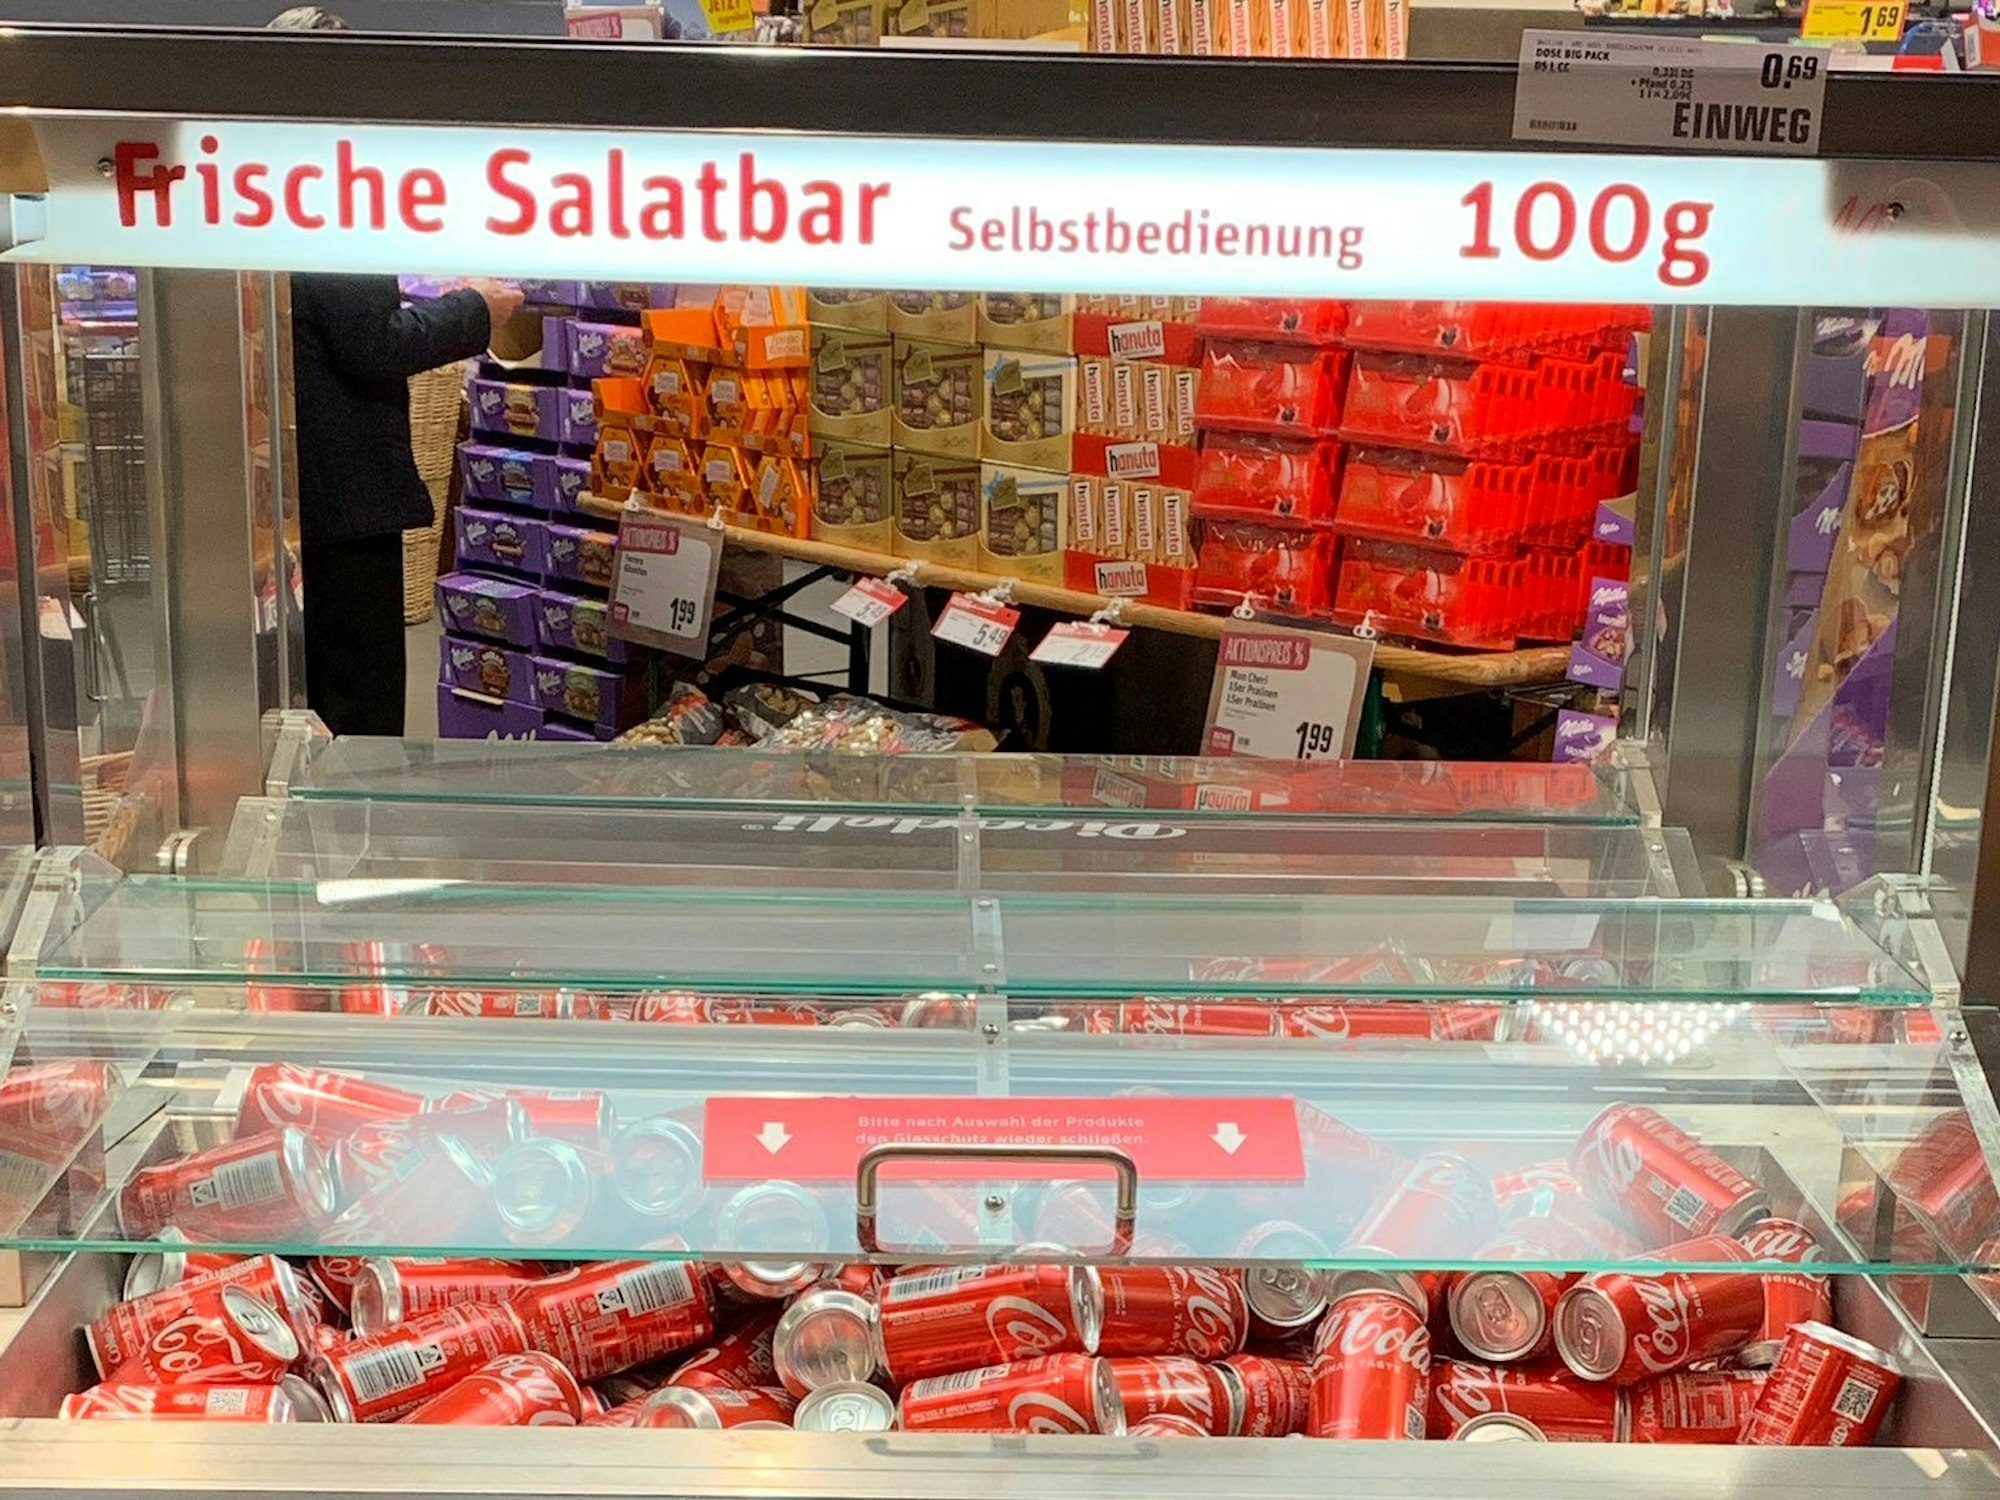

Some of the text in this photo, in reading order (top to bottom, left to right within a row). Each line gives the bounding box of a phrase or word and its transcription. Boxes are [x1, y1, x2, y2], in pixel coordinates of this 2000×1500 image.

[1860, 6, 1899, 36] 1.69
[1535, 48, 1610, 61] DOSE BIG PACK
[1761, 53, 1819, 90] 0.69
[1639, 78, 1667, 88] Pfand
[1673, 102, 1812, 144] EINWEG
[115, 135, 1714, 287] Frische Salatbar Selbstbedienung 100g
[1111, 325, 1162, 353] hanuta
[1087, 366, 1101, 420] hanuta
[1118, 369, 1131, 424] hanuta
[1147, 373, 1160, 428] hanuta
[1179, 376, 1192, 432] hanuta
[1109, 446, 1157, 472] hanuta
[1077, 485, 1091, 538] hanuta
[1107, 489, 1120, 543] hanuta
[1138, 494, 1150, 548] hanuta
[1167, 498, 1180, 553] hanuta
[1098, 566, 1145, 590] hanuta
[670, 597, 696, 631] 1.99
[1230, 670, 1247, 681] Mon
[1246, 684, 1279, 698] Pralinen
[1296, 721, 1334, 759] 1.99
[858, 1115, 1145, 1128] Bitte nach Auswahl der Produkte
